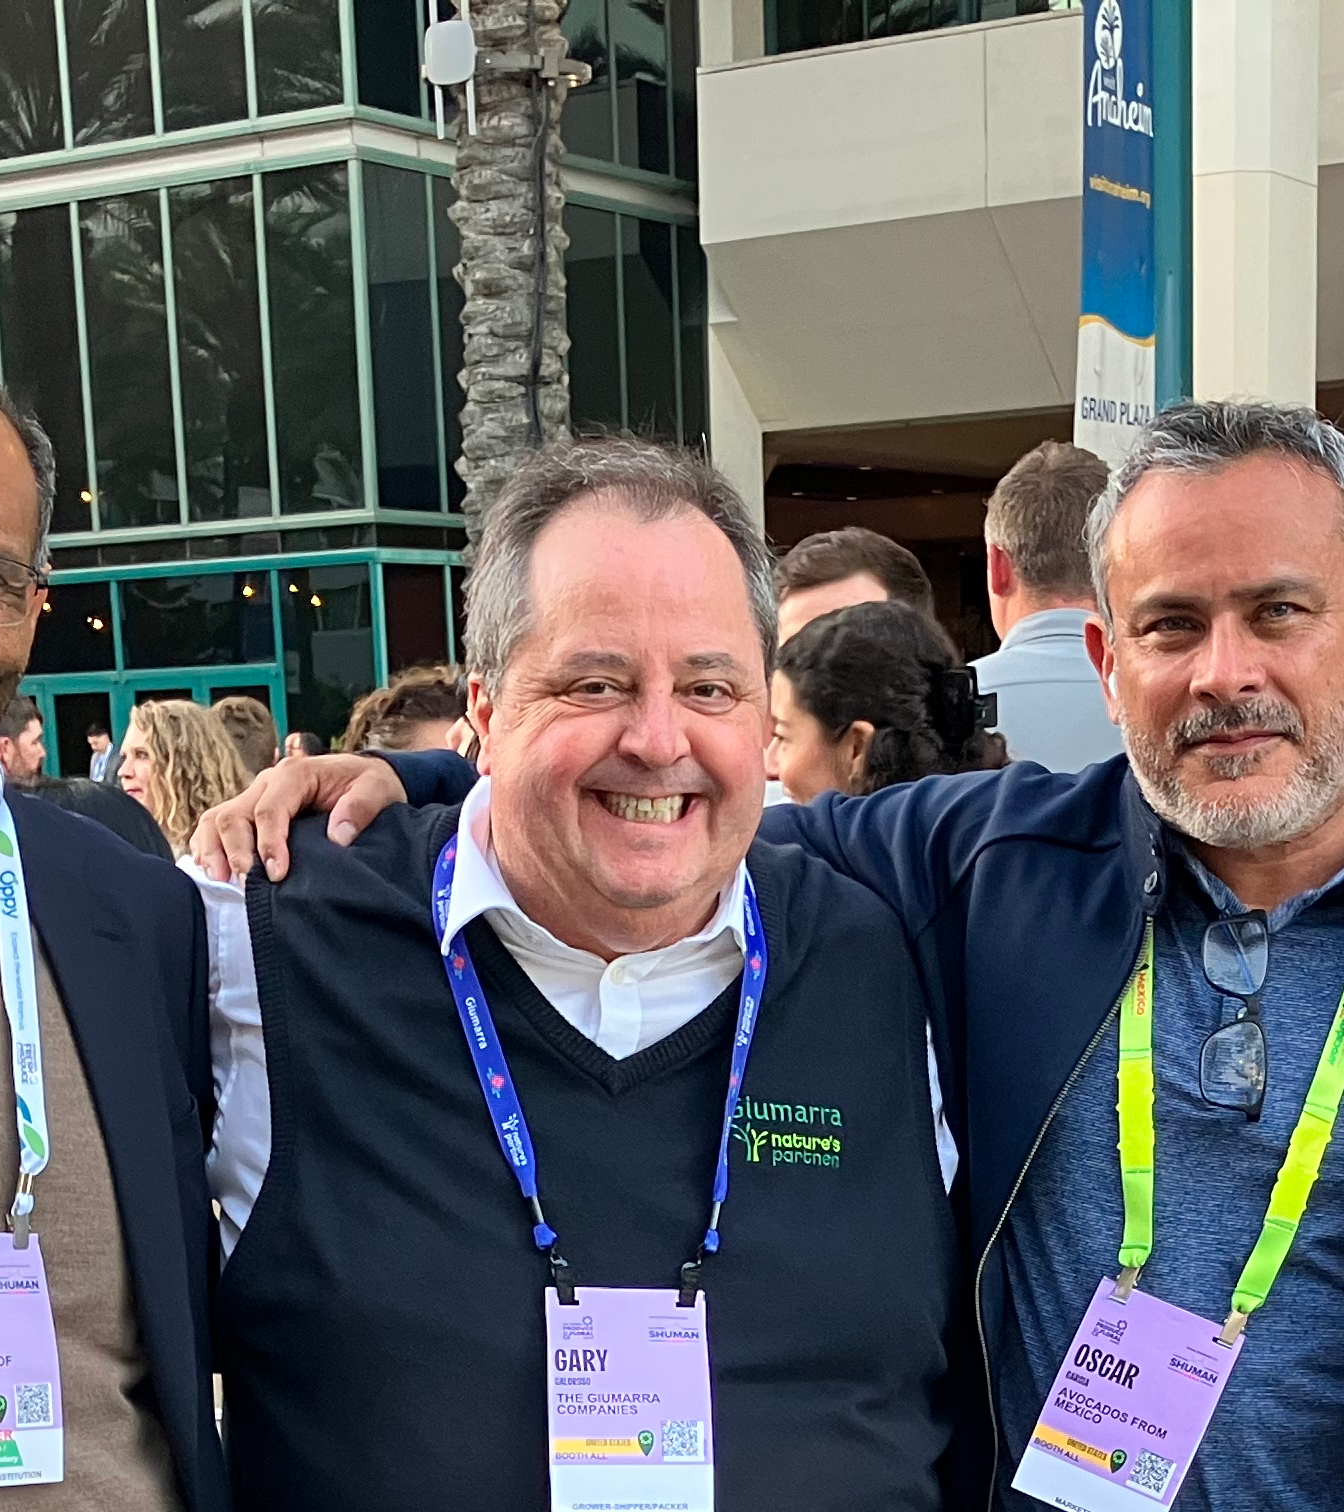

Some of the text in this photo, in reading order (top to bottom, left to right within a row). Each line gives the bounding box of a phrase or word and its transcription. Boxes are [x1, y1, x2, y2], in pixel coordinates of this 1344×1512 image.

[1087, 58, 1154, 138] Anaheim
[1082, 396, 1152, 427] GRAND PLAZA
[465, 996, 488, 1050] Giumarra
[771, 1132, 841, 1152] nature's
[648, 1330, 700, 1339] SHUMAN
[554, 1349, 608, 1372] GARY
[1074, 1344, 1140, 1390] OSCAR
[1169, 1357, 1218, 1384] SHUMAN
[557, 1393, 661, 1404] THE GIUMARRA
[557, 1405, 639, 1415] COMPANIES
[1053, 1397, 1102, 1424] MEXICO
[1057, 1387, 1168, 1440] AVOCADOS FROM
[556, 1452, 609, 1460] BOOTH ALL
[1034, 1437, 1064, 1455] BOOTH
